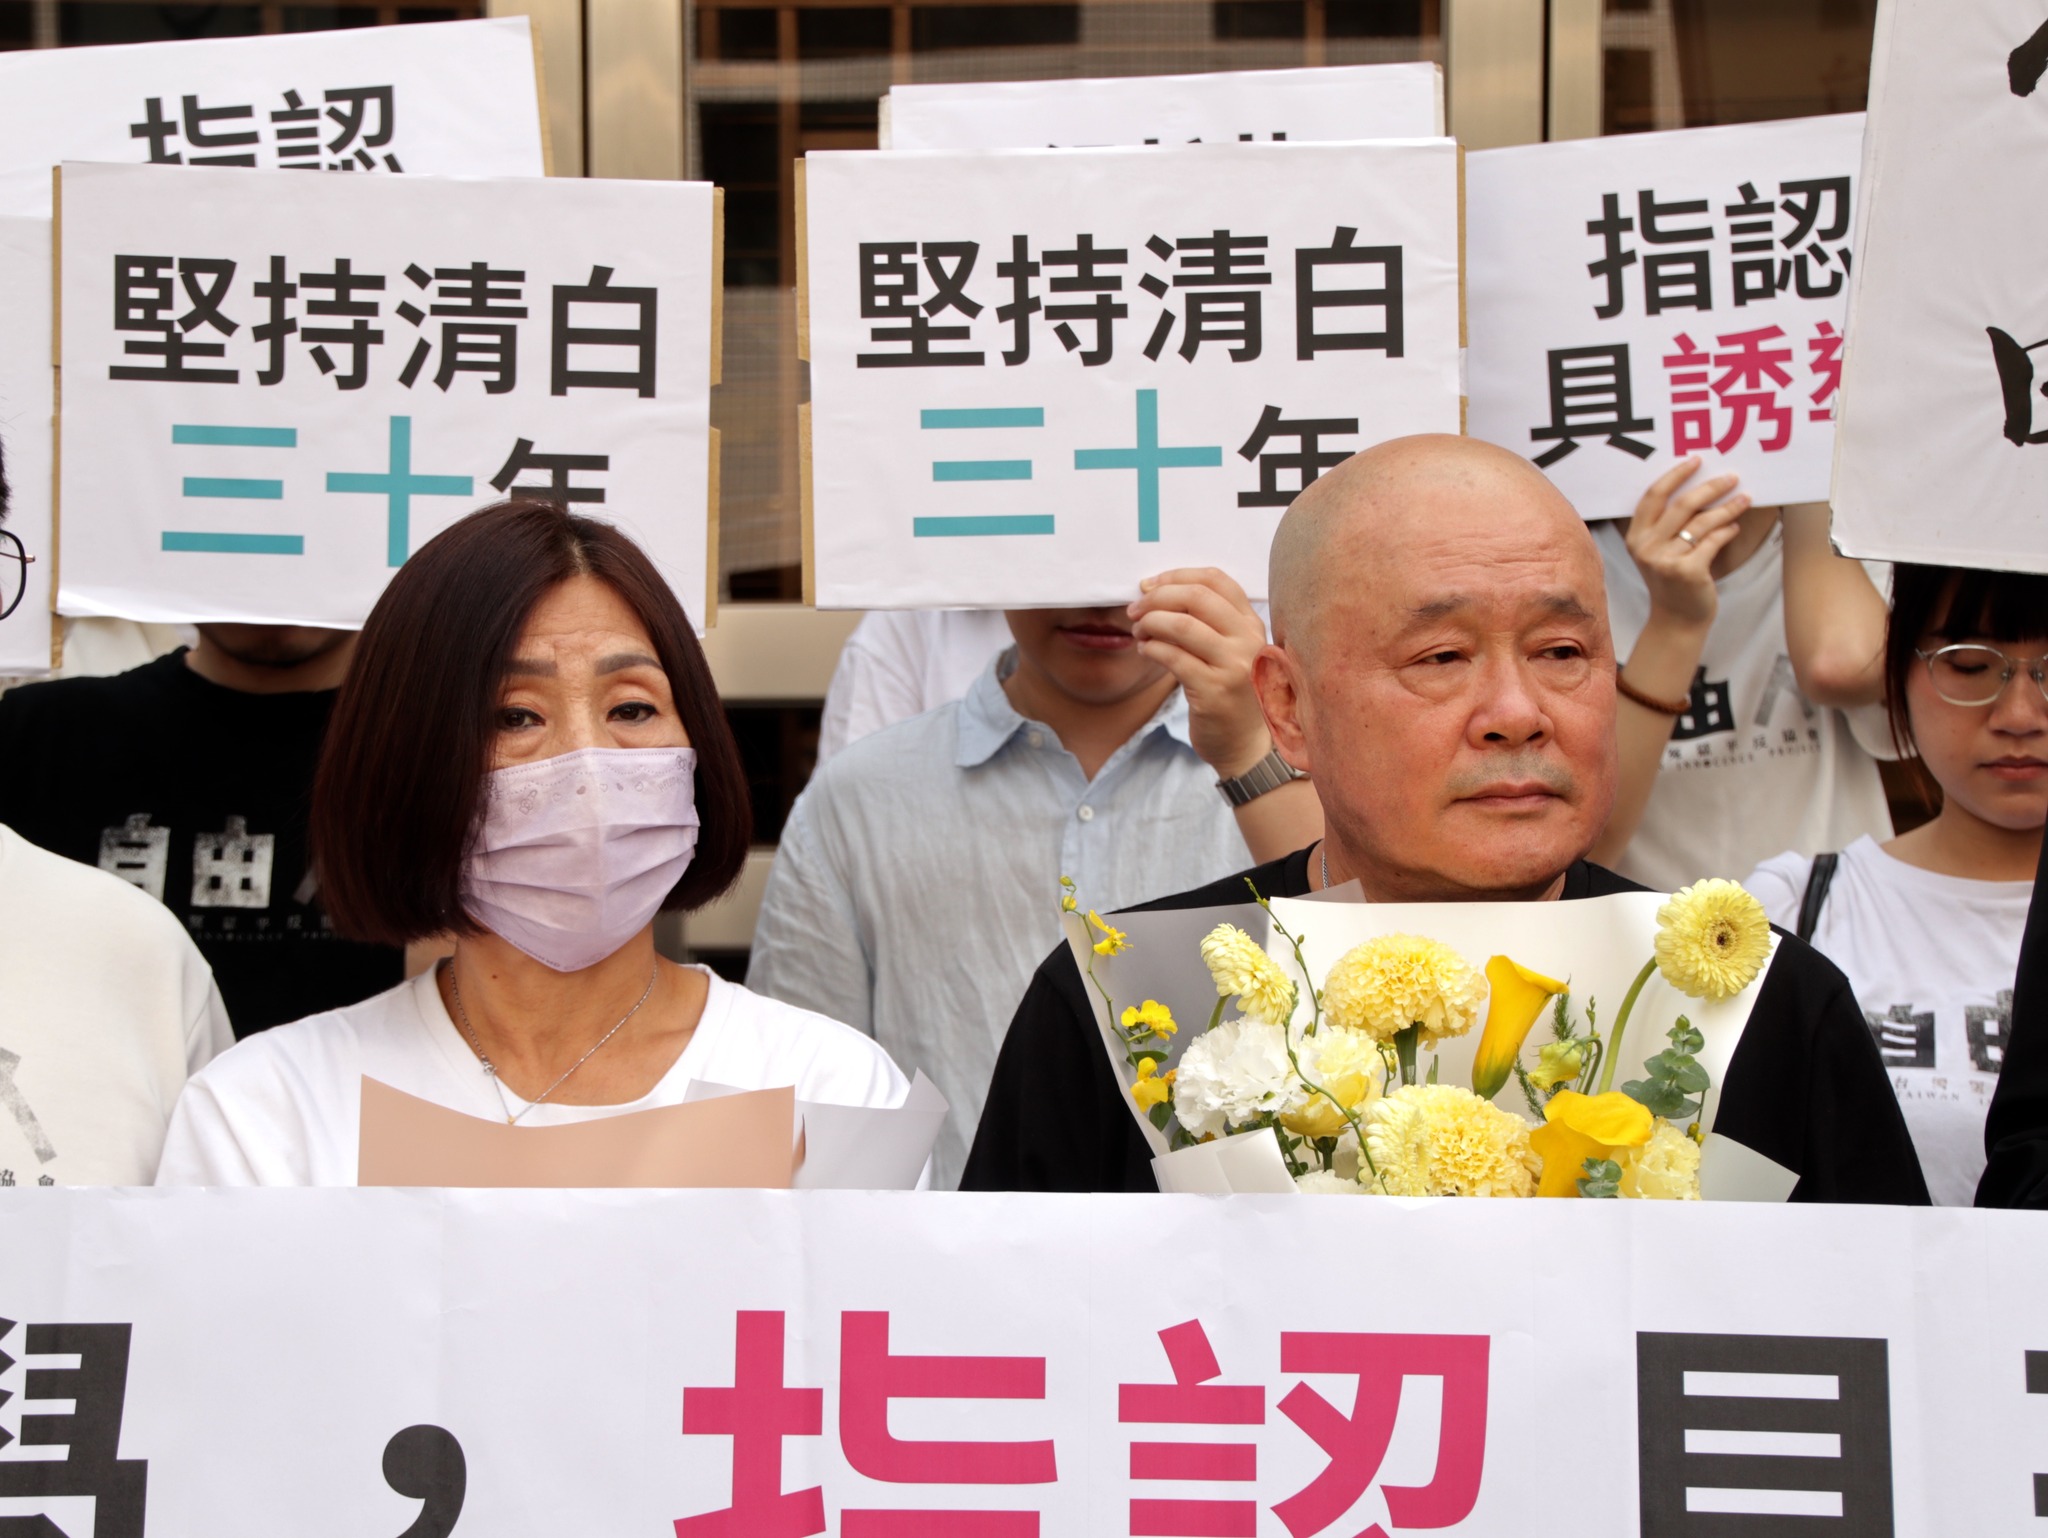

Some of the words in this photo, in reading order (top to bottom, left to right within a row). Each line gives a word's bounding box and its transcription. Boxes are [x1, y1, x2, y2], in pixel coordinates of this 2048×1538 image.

[856, 226, 1404, 369] 堅持清白
[1586, 176, 1852, 320] 指認
[109, 254, 658, 399] 堅持清白
[913, 389, 1359, 543] 三十年
